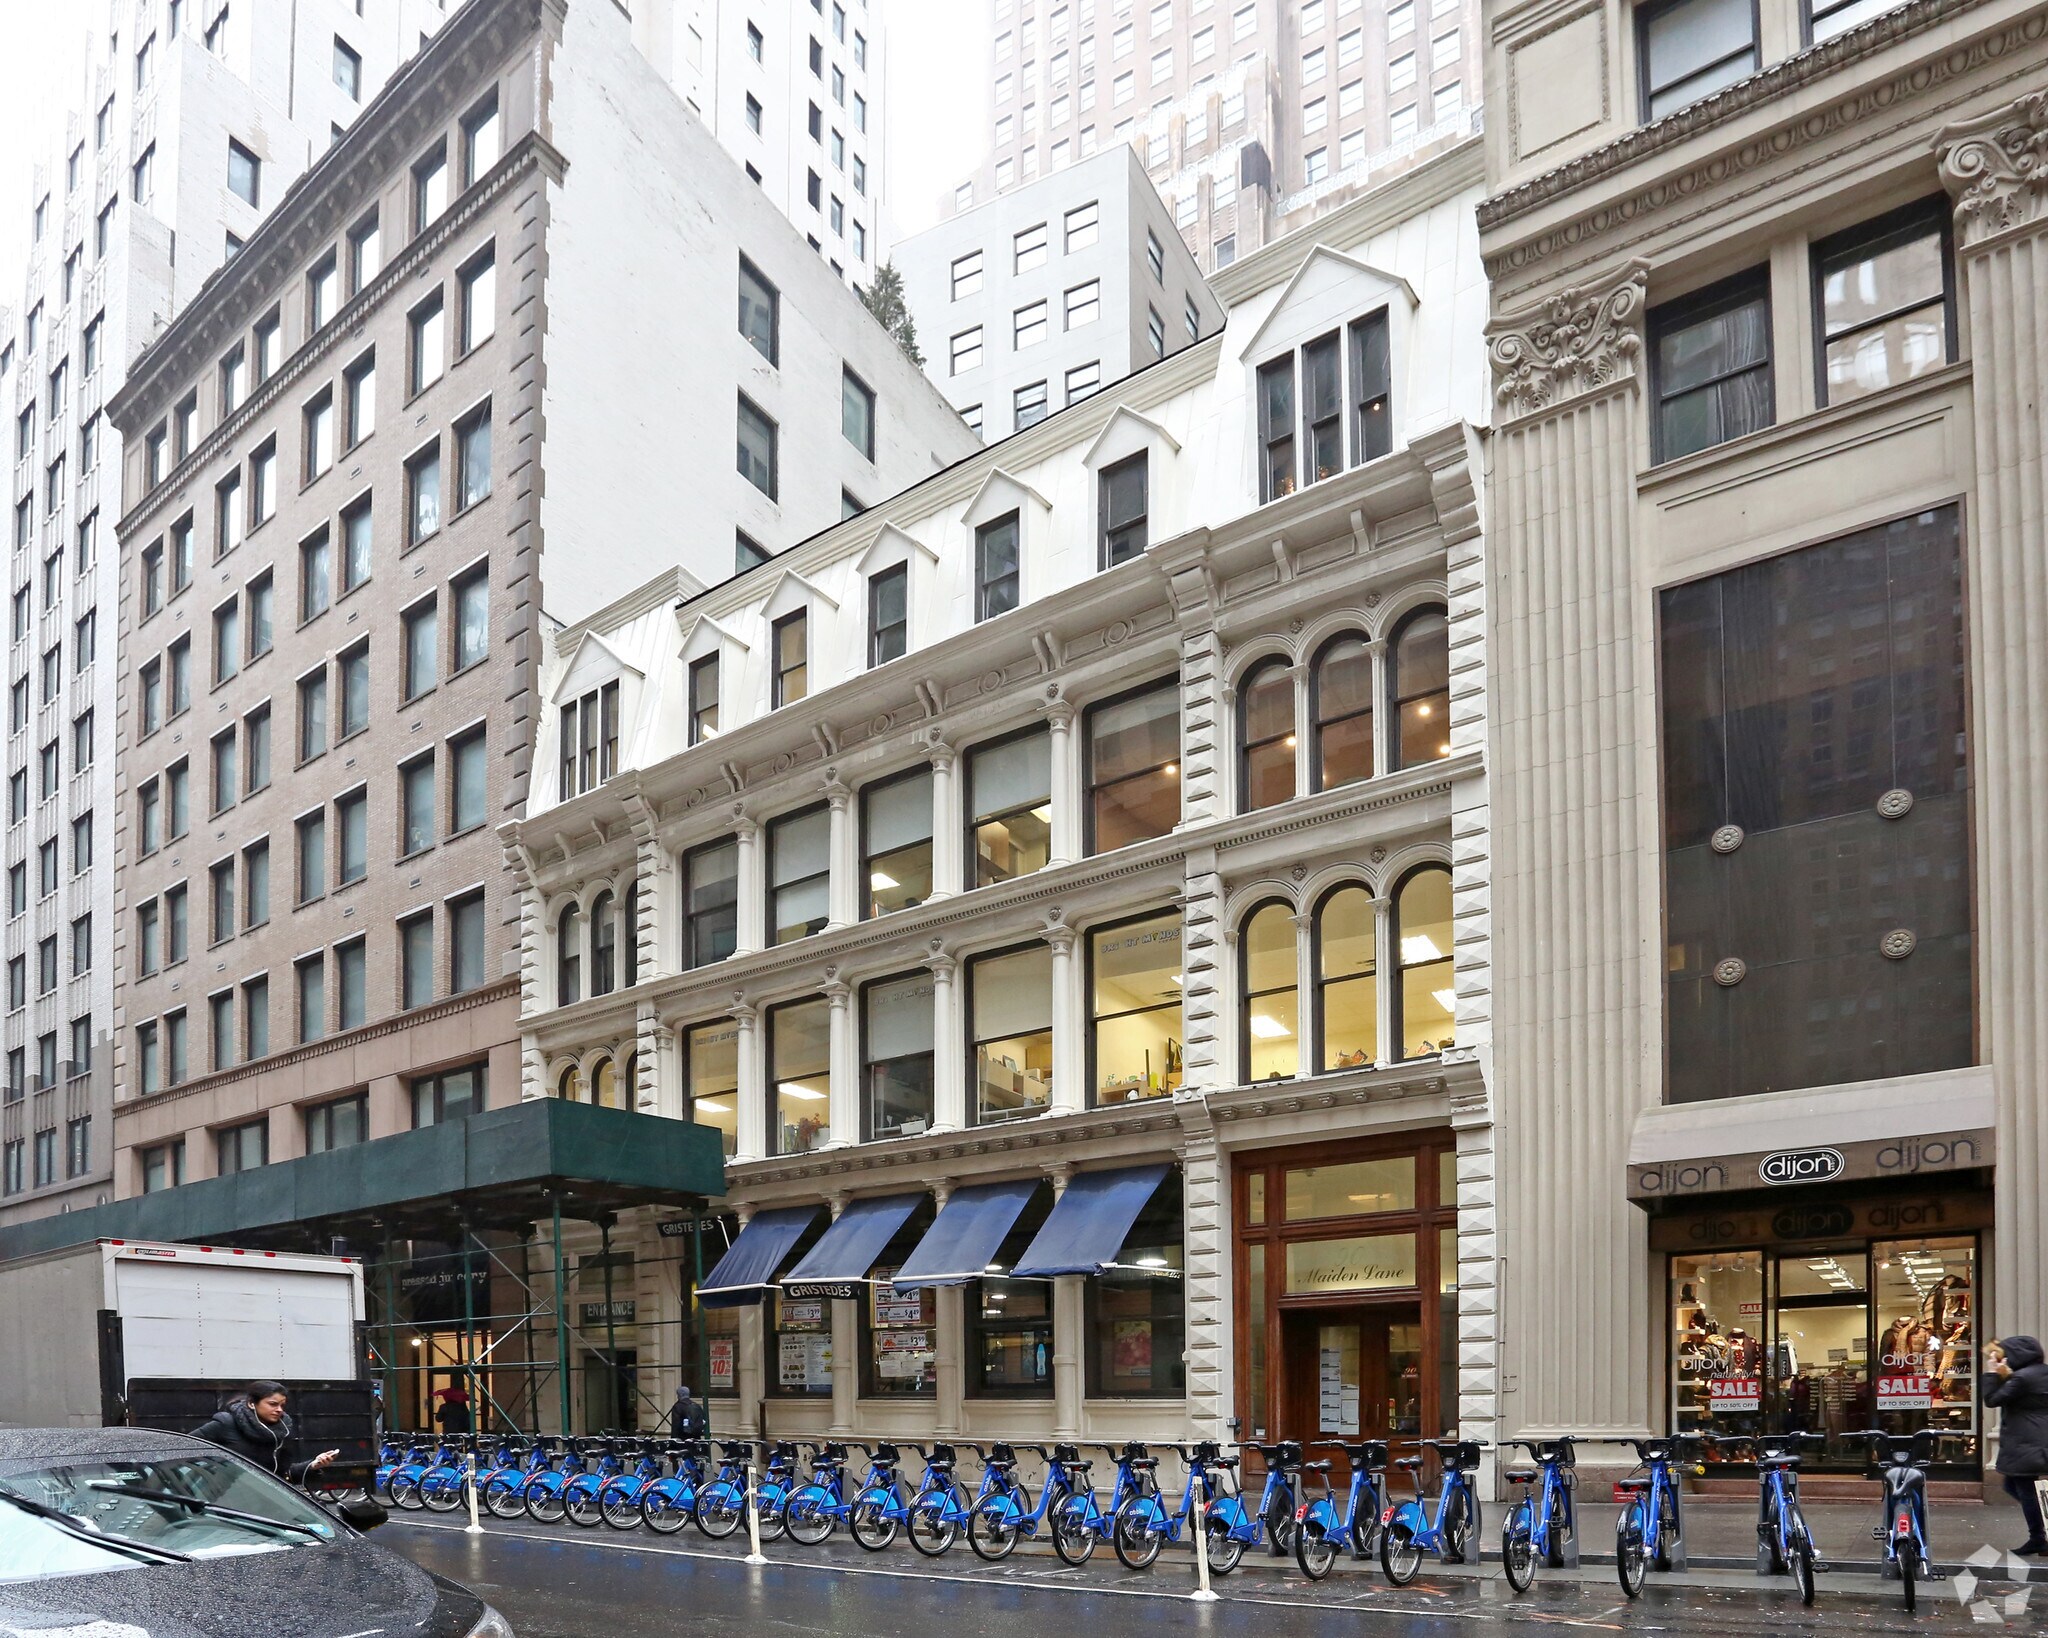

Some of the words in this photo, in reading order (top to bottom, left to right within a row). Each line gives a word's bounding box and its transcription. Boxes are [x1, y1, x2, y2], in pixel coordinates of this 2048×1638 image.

[1877, 1138, 1975, 1173] dijon
[1767, 1156, 1832, 1179] dijon
[1640, 1163, 1724, 1194] dijon
[662, 1220, 714, 1235] GRISTEES
[1298, 1266, 1359, 1283] Maiden
[1363, 1264, 1404, 1280] Lane
[789, 1284, 852, 1297] GRISTEDES
[1711, 1382, 1758, 1396] SALE
[1878, 1379, 1930, 1394] SALE
